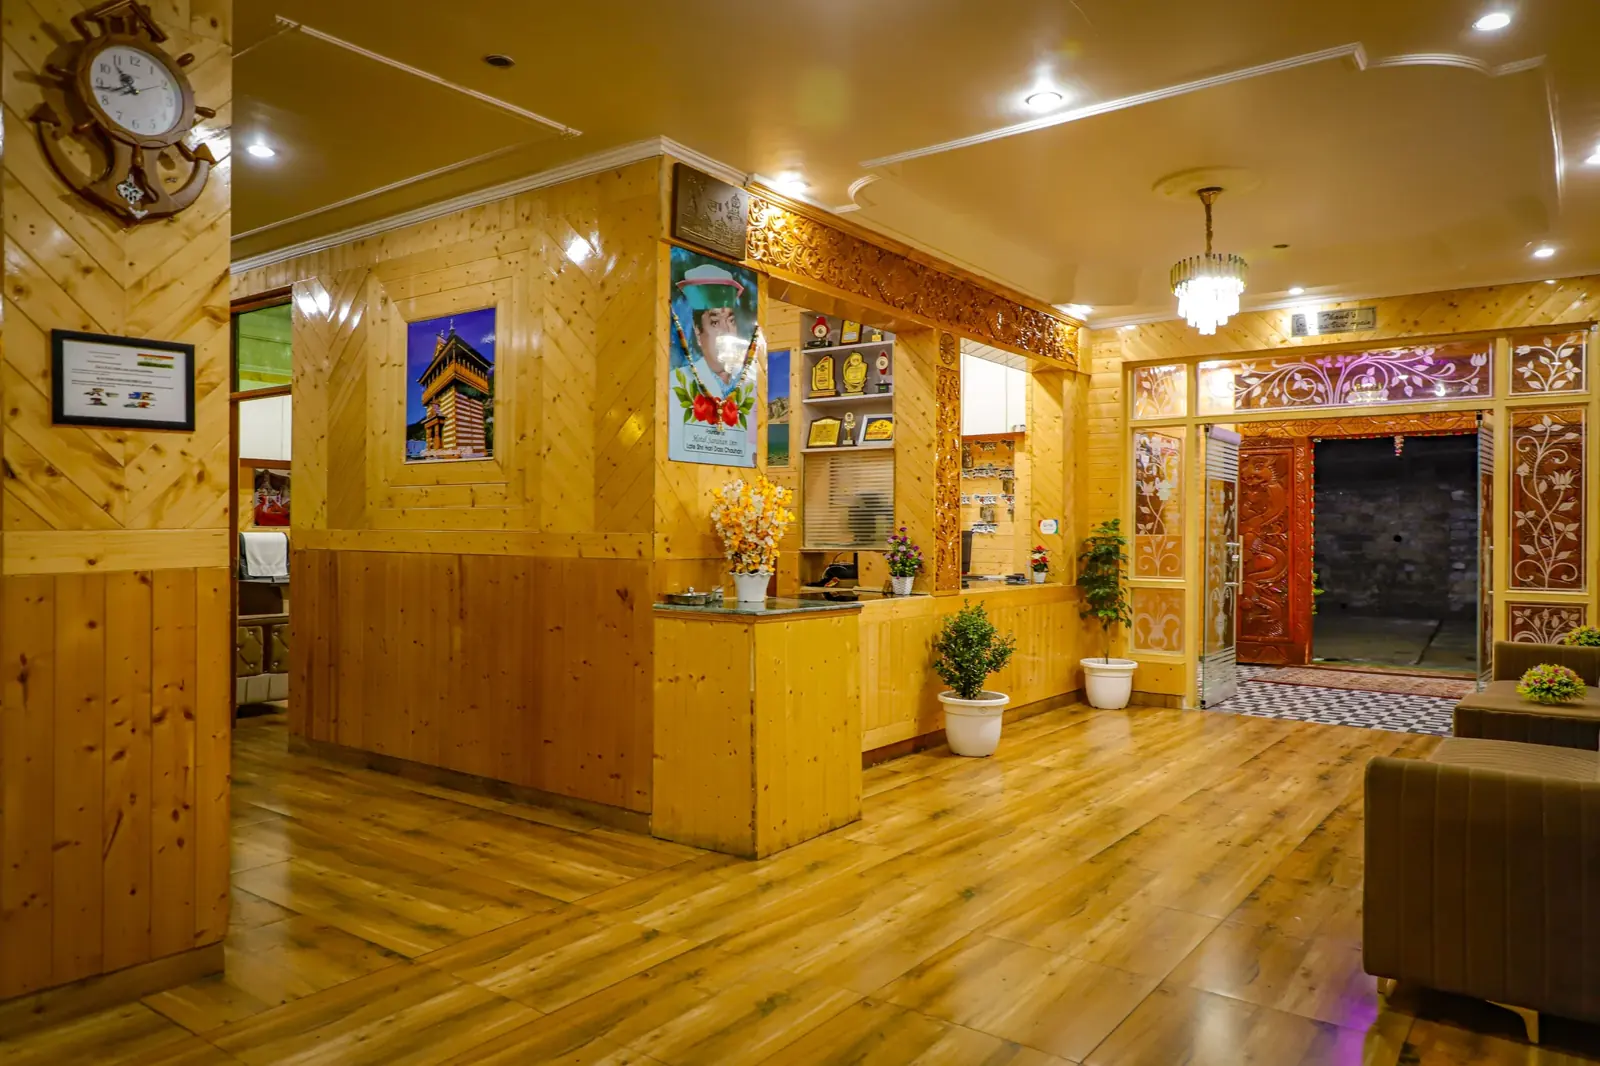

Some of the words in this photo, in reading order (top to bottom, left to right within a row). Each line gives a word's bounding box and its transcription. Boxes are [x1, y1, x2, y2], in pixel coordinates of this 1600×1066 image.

[130, 55, 141, 67] 12
[100, 63, 111, 74] 10
[95, 77, 104, 87] 9
[161, 79, 168, 90] 2
[101, 95, 109, 105] 8
[166, 96, 173, 107] 3
[115, 110, 122, 121] 7
[131, 119, 139, 129] 6
[149, 119, 156, 129] 5
